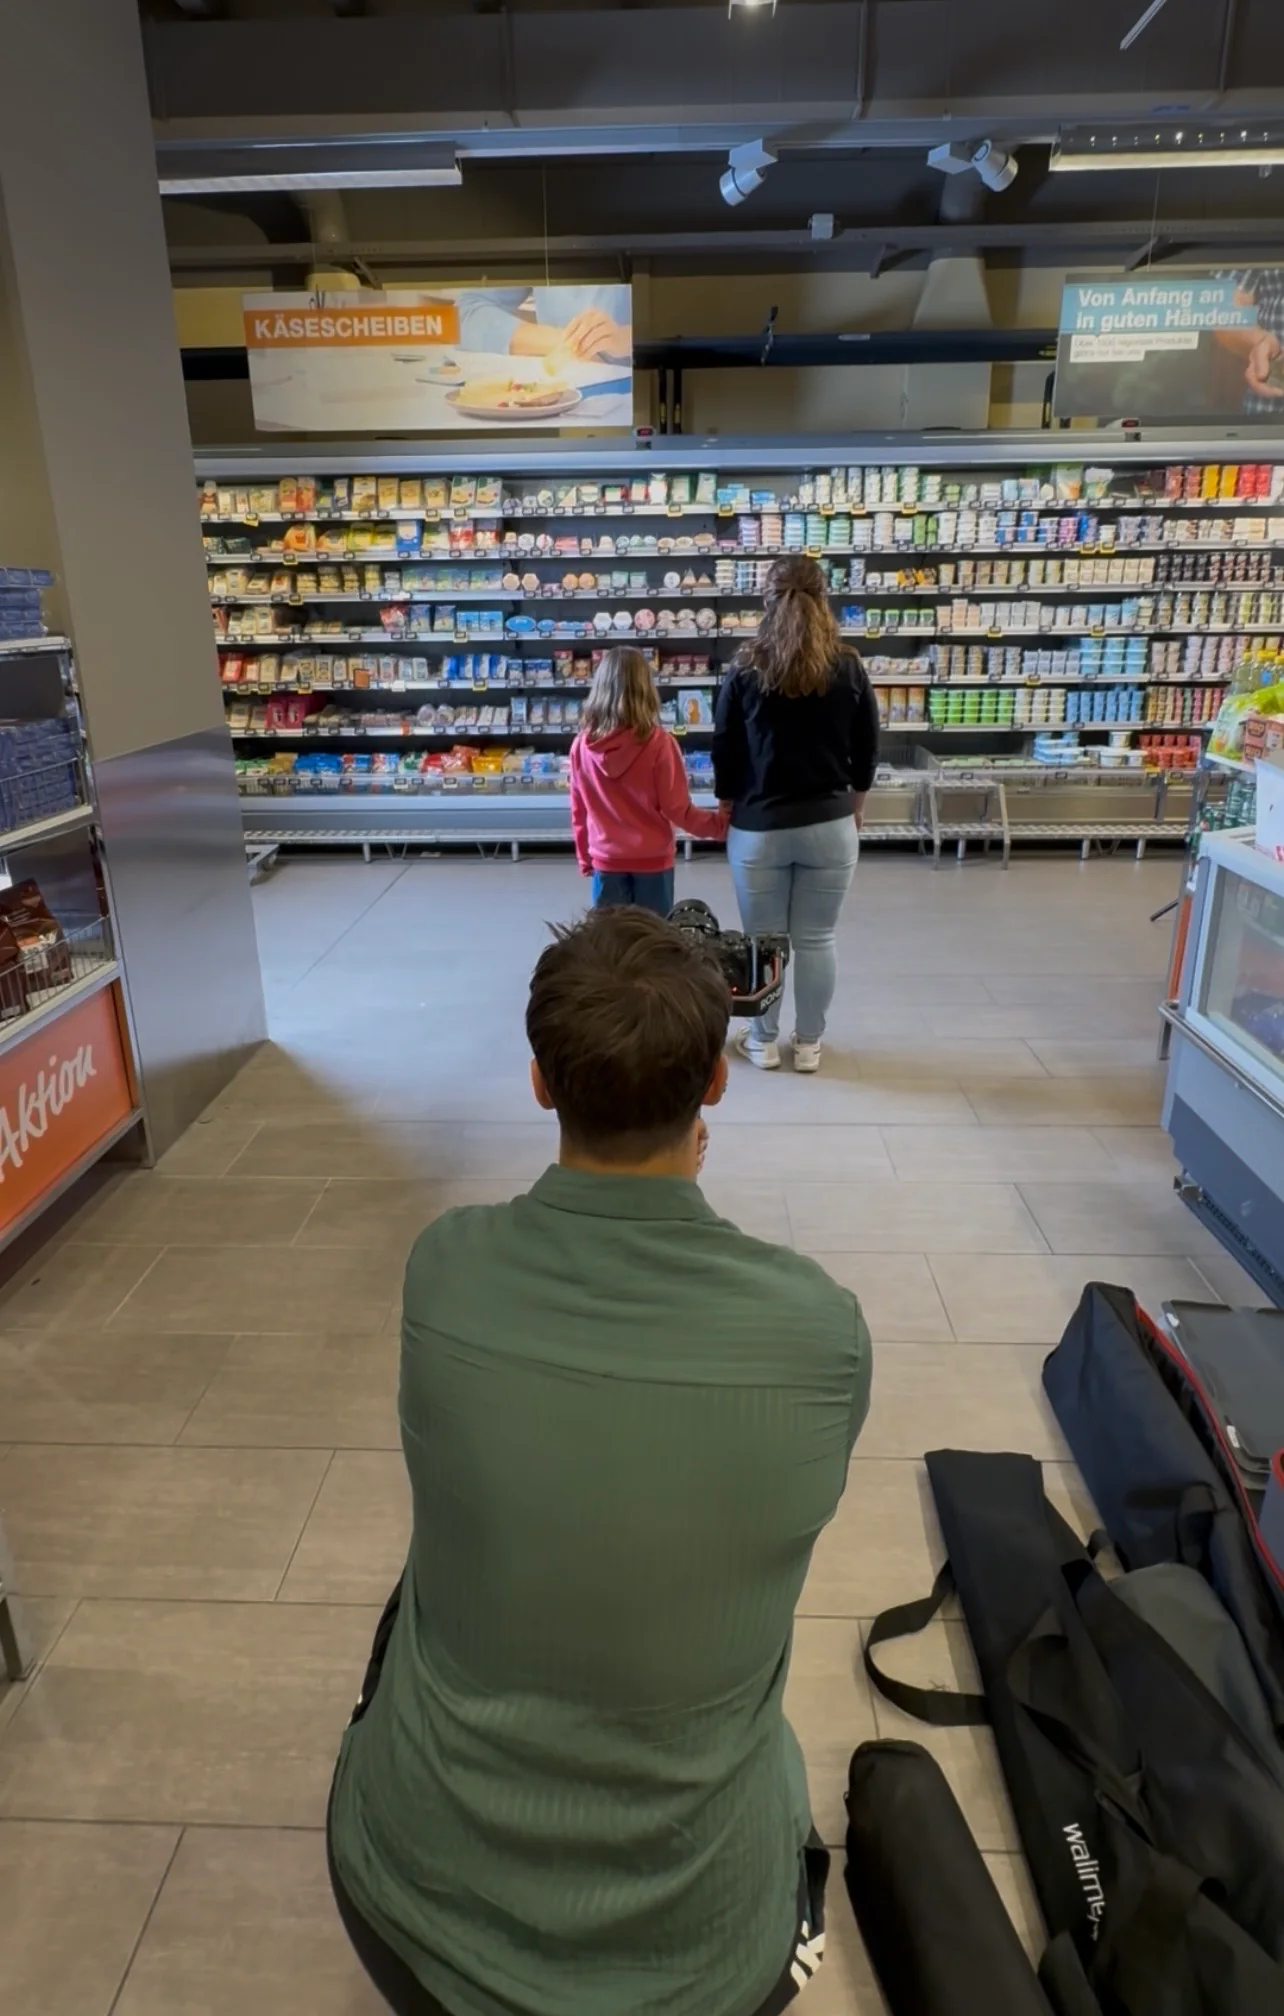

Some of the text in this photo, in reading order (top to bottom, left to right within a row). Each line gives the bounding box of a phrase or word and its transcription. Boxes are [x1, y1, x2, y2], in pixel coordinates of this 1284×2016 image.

[1078, 286, 1224, 307] Von Anfang an
[254, 313, 443, 339] KÄSESCHEIBEN
[1100, 311, 1157, 332] guten
[1164, 307, 1248, 328] Händen.
[0, 1044, 97, 1183] Aktion
